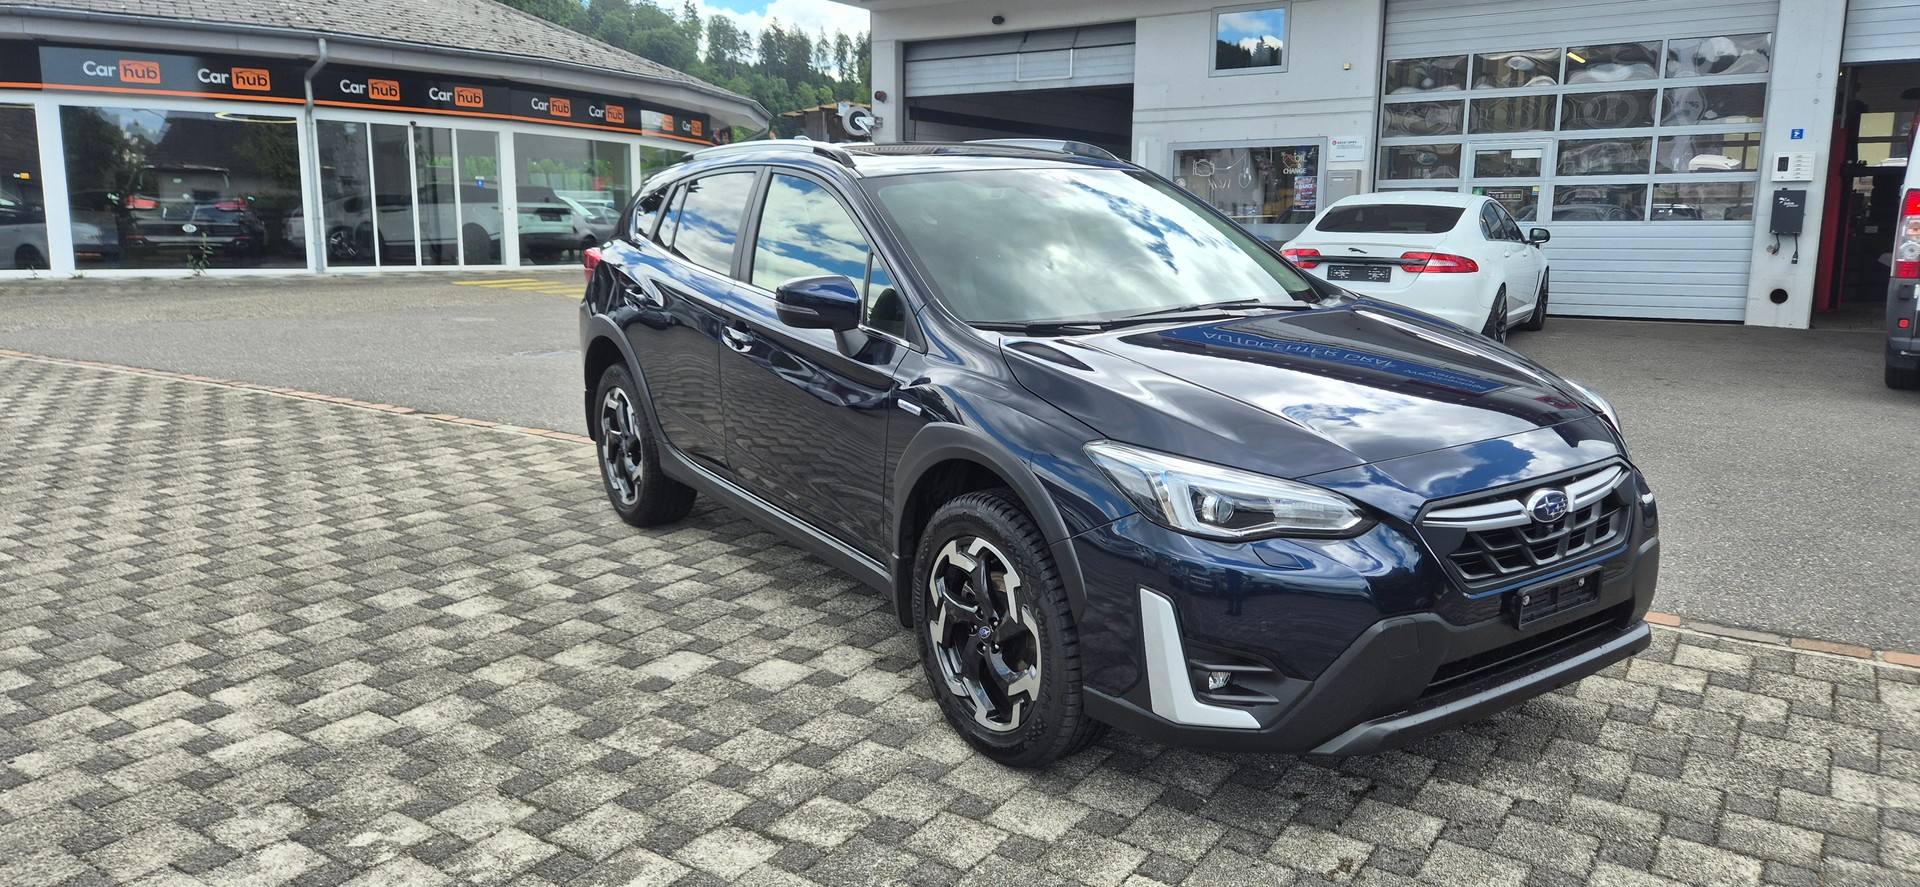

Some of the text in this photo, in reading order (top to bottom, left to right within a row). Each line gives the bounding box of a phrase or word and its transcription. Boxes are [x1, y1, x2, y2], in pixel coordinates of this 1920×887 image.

[83, 61, 158, 80] Car hub
[197, 68, 268, 87] Car hub
[340, 79, 398, 98] Car hub
[428, 88, 481, 105] Car hub
[531, 98, 570, 114] Car hub
[589, 105, 624, 121] Car hub
[682, 121, 691, 131] Car
